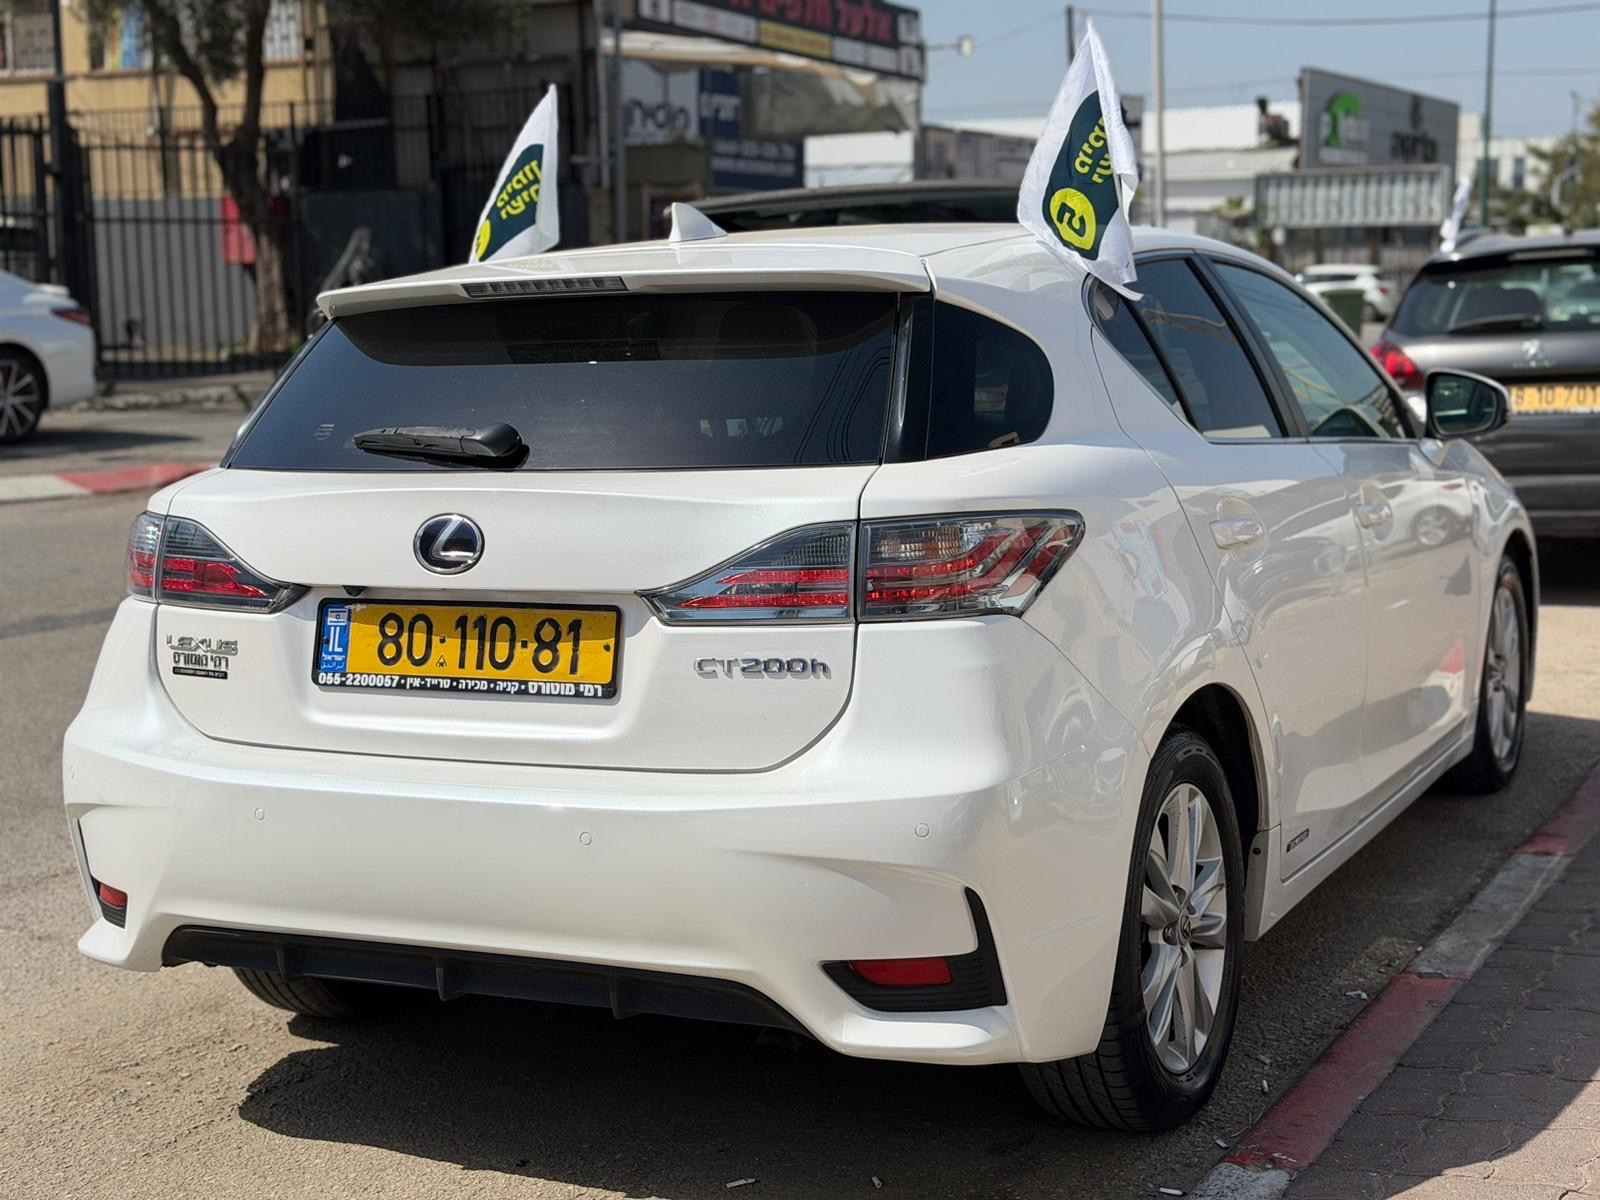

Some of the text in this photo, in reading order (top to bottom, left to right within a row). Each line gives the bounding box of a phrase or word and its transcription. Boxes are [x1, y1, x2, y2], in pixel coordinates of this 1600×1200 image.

[166, 634, 239, 656] LEXUS
[328, 626, 344, 653] IL
[318, 672, 603, 697] רמי מוטורס קניה מכירה טרייד-אין 055-2200057
